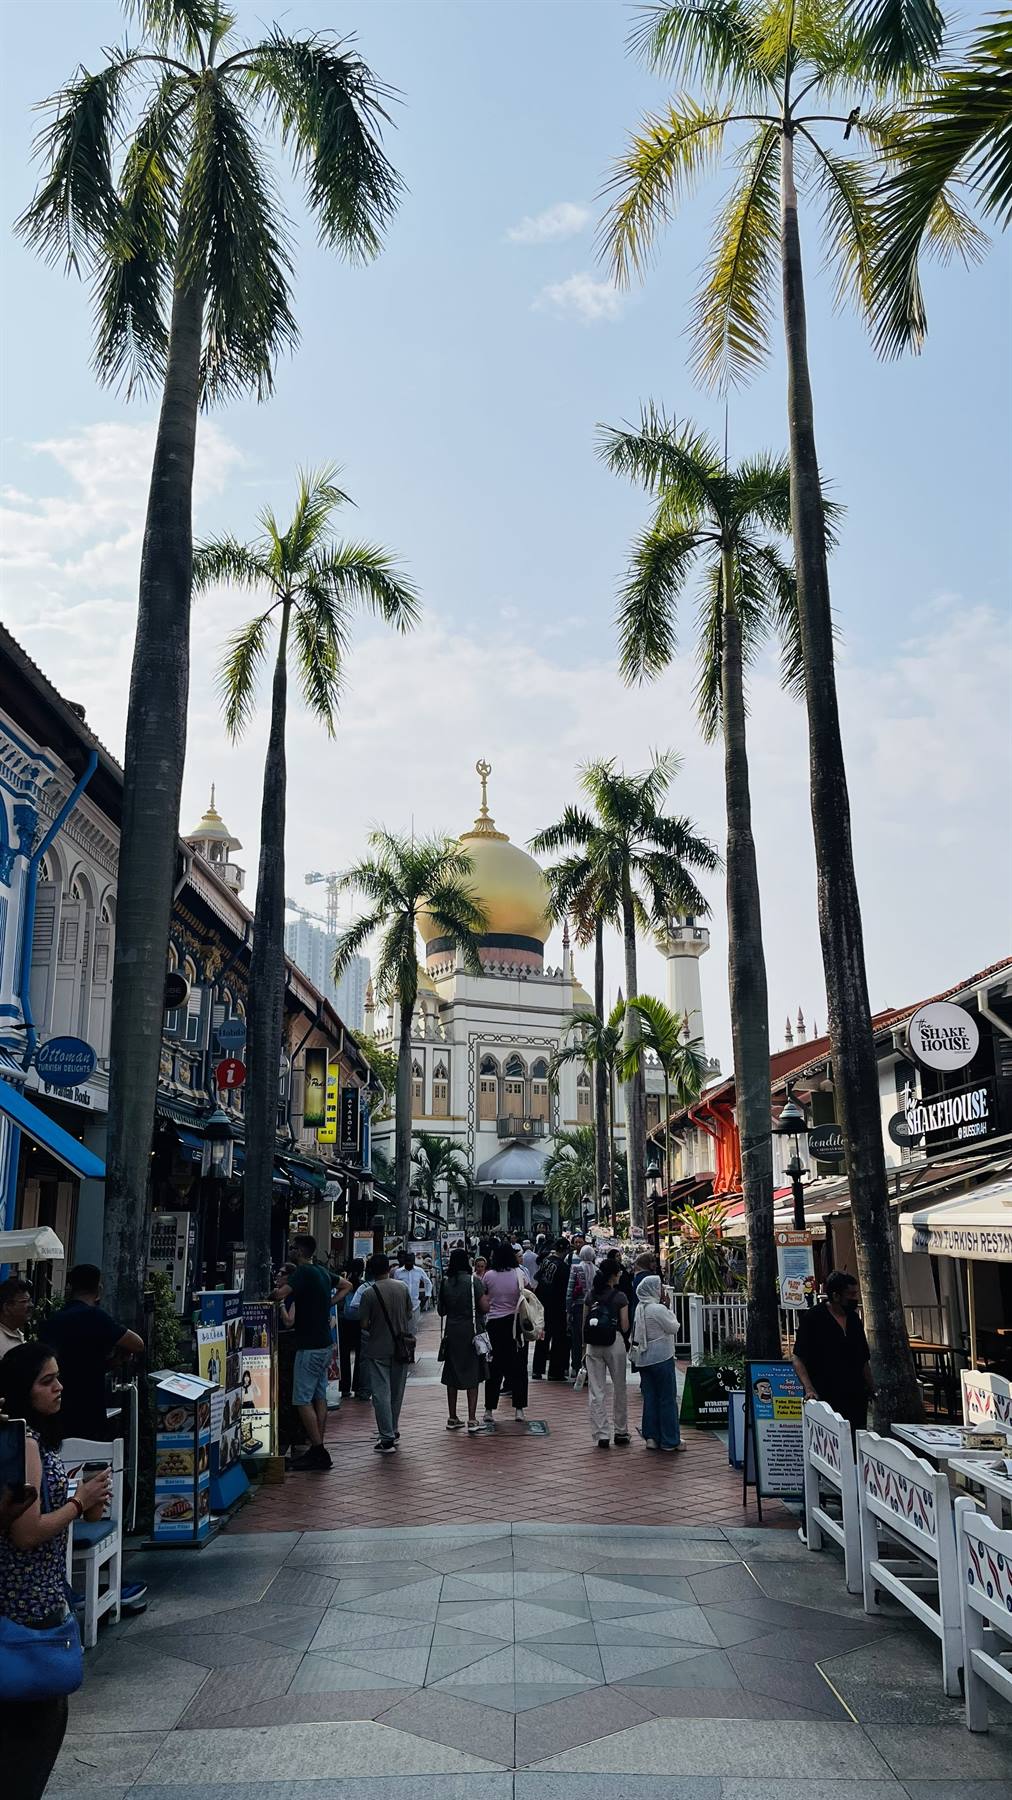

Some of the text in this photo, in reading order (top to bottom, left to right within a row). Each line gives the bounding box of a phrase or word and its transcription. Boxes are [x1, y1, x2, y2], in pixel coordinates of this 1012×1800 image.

[920, 1027, 967, 1040] SHAKE
[922, 1038, 972, 1051] HOUSE
[39, 1045, 91, 1063] Ottoman
[38, 1064, 90, 1073] TURKISH DELIGHTS
[75, 1087, 91, 1106] Books
[907, 1088, 989, 1136] SHAKEHOUSE
[963, 1121, 987, 1139] BUSSORAH
[944, 1231, 978, 1252] TURKISH
